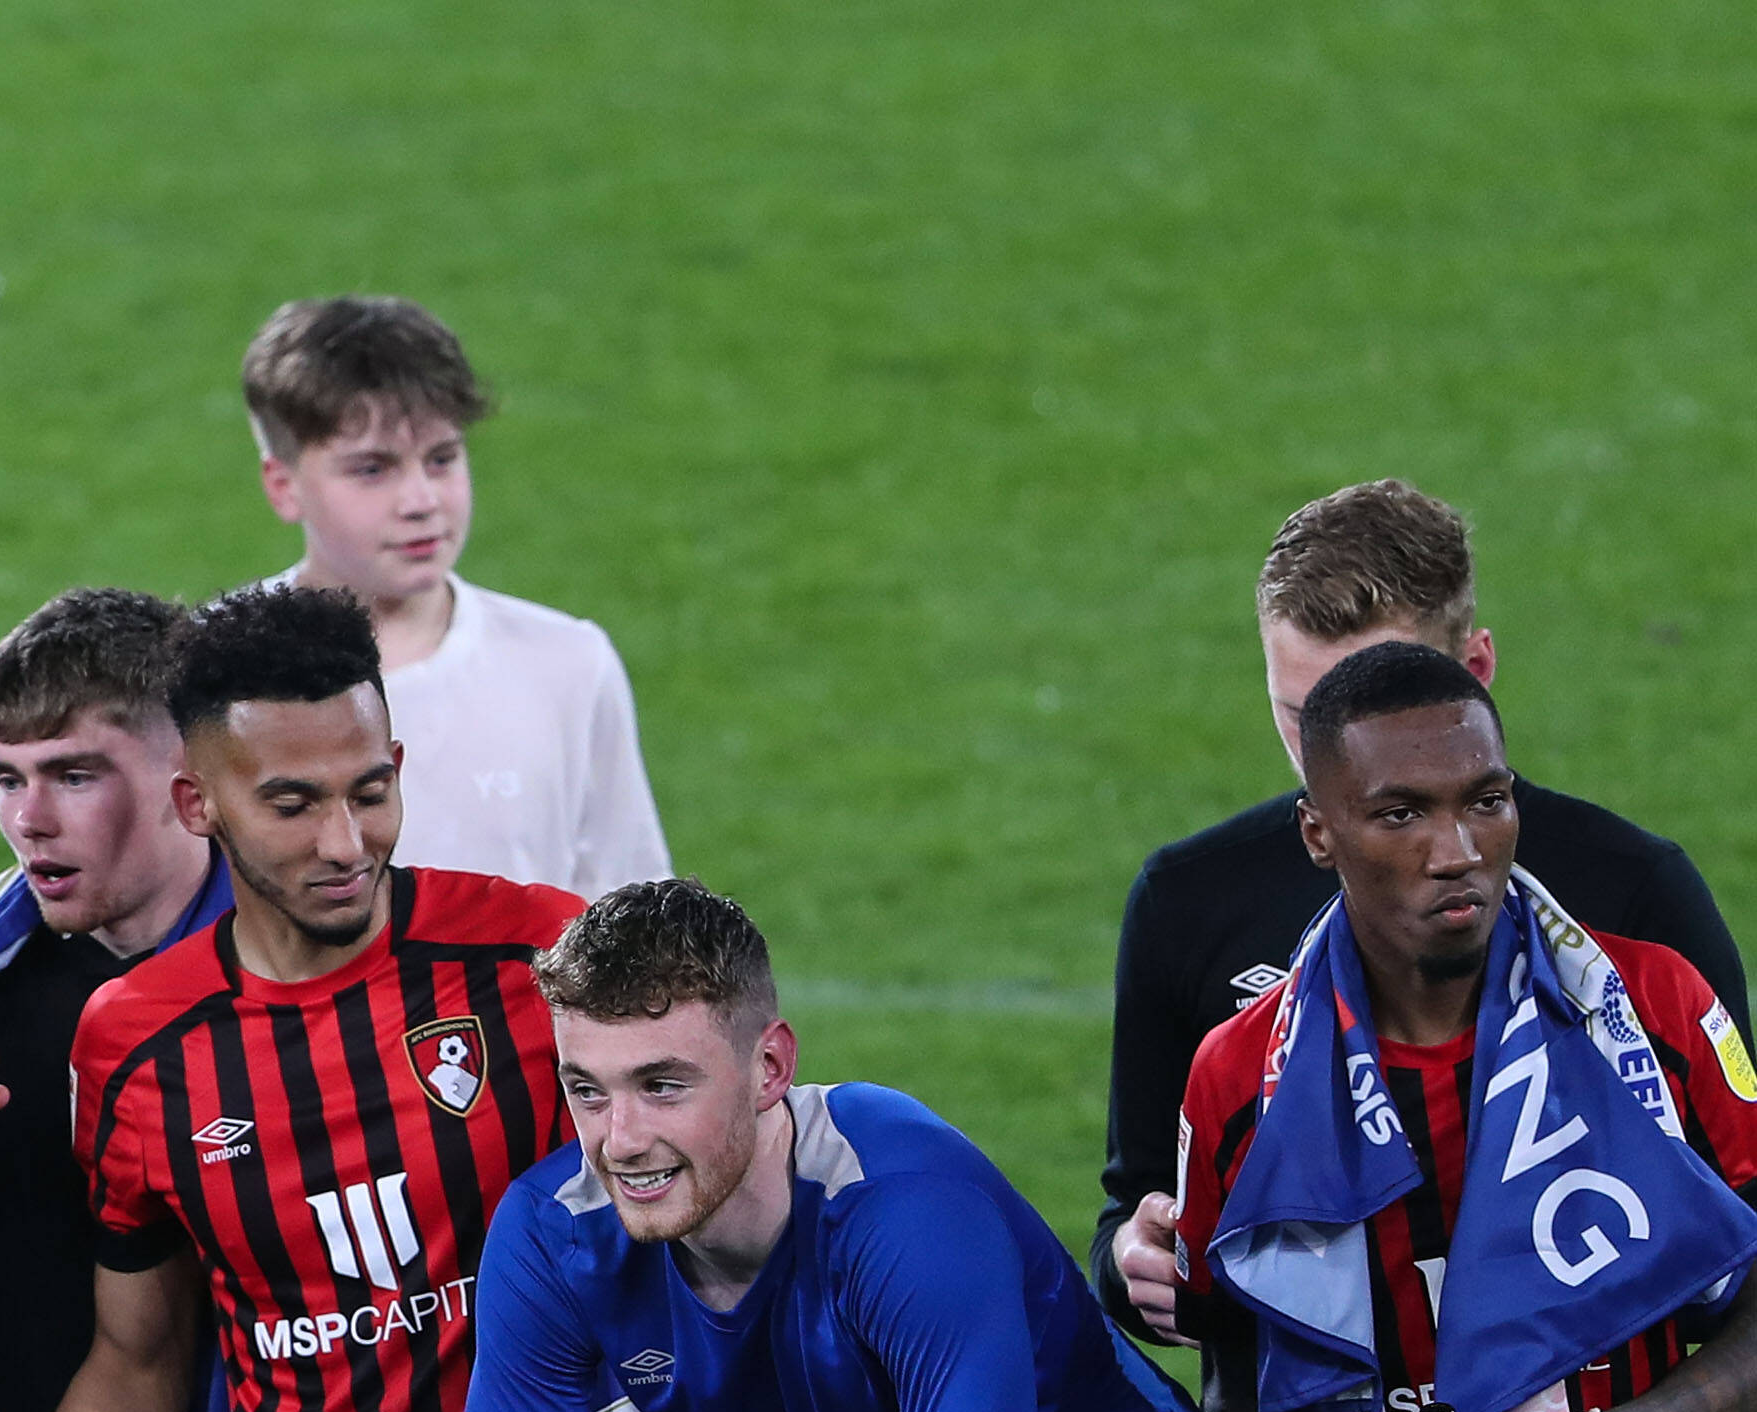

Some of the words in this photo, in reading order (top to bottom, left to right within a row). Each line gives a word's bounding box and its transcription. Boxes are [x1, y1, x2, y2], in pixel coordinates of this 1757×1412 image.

[202, 1143, 252, 1164] umbro
[253, 1275, 476, 1360] MSPCAPIT
[627, 1373, 675, 1387] umbro
